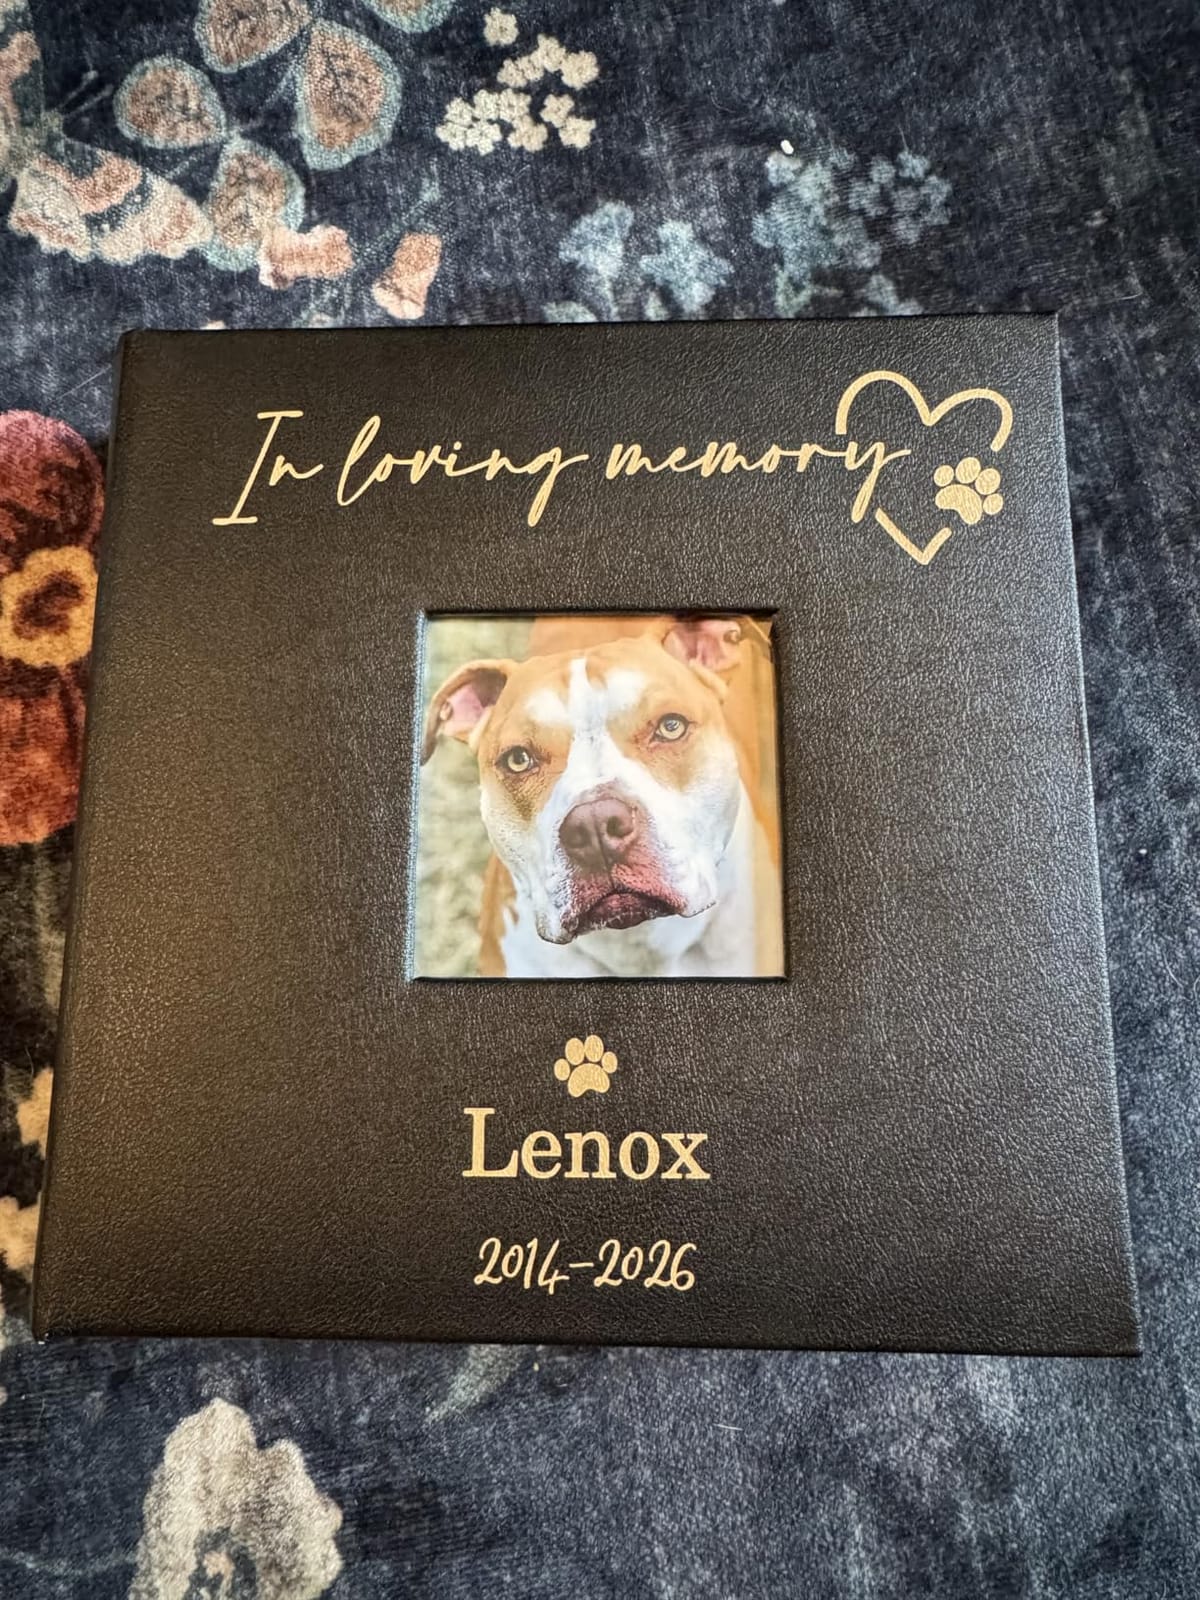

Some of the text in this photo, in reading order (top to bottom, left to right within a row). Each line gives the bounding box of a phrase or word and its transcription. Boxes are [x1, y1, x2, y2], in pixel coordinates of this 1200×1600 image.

[211, 409, 913, 528] In loving memory
[461, 1107, 712, 1180] Lenox
